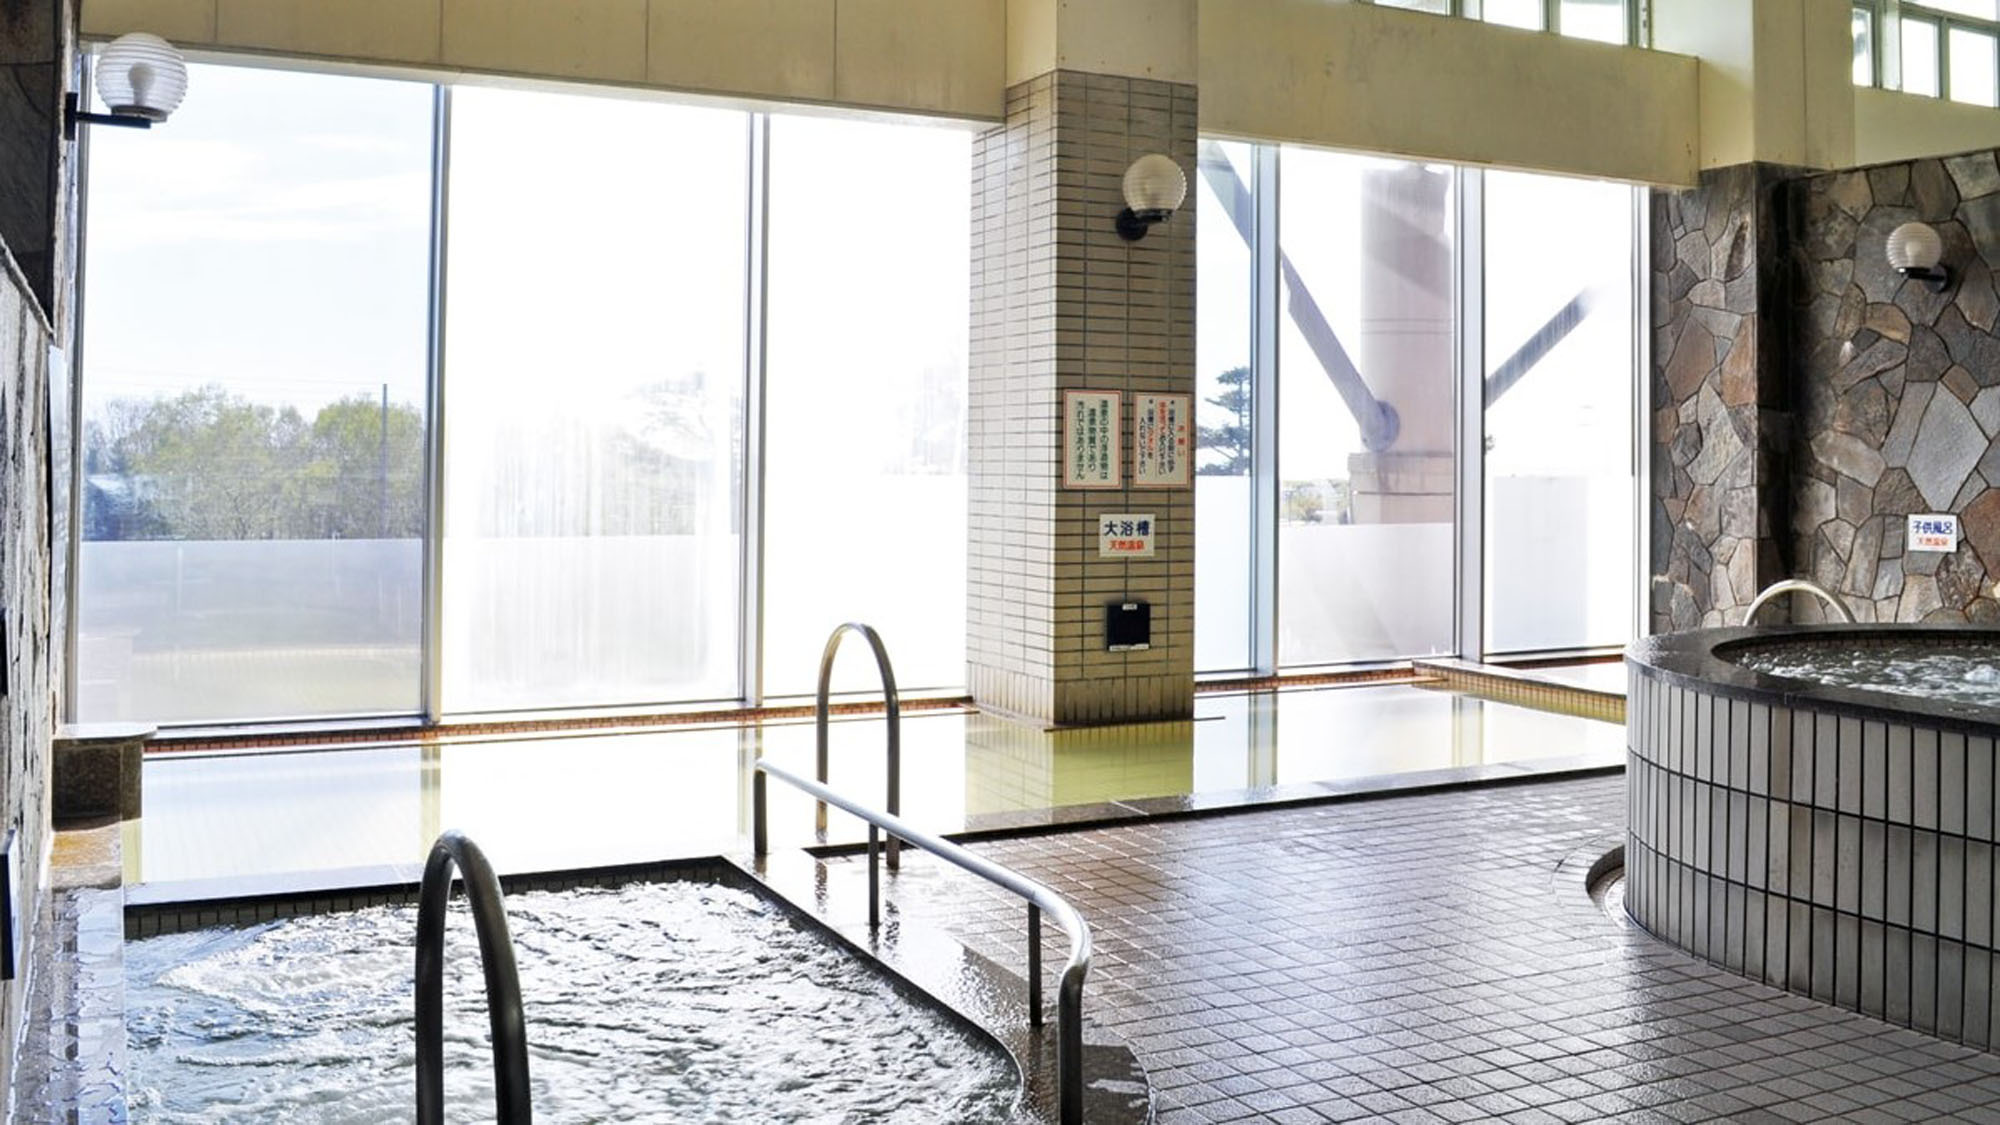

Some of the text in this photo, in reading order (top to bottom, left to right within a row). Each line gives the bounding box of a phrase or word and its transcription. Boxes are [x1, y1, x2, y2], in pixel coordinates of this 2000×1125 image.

[1104, 520, 1150, 536] 大浴槽
[1912, 520, 1953, 534] 子供風呂
[1108, 540, 1145, 551] 天然温泉
